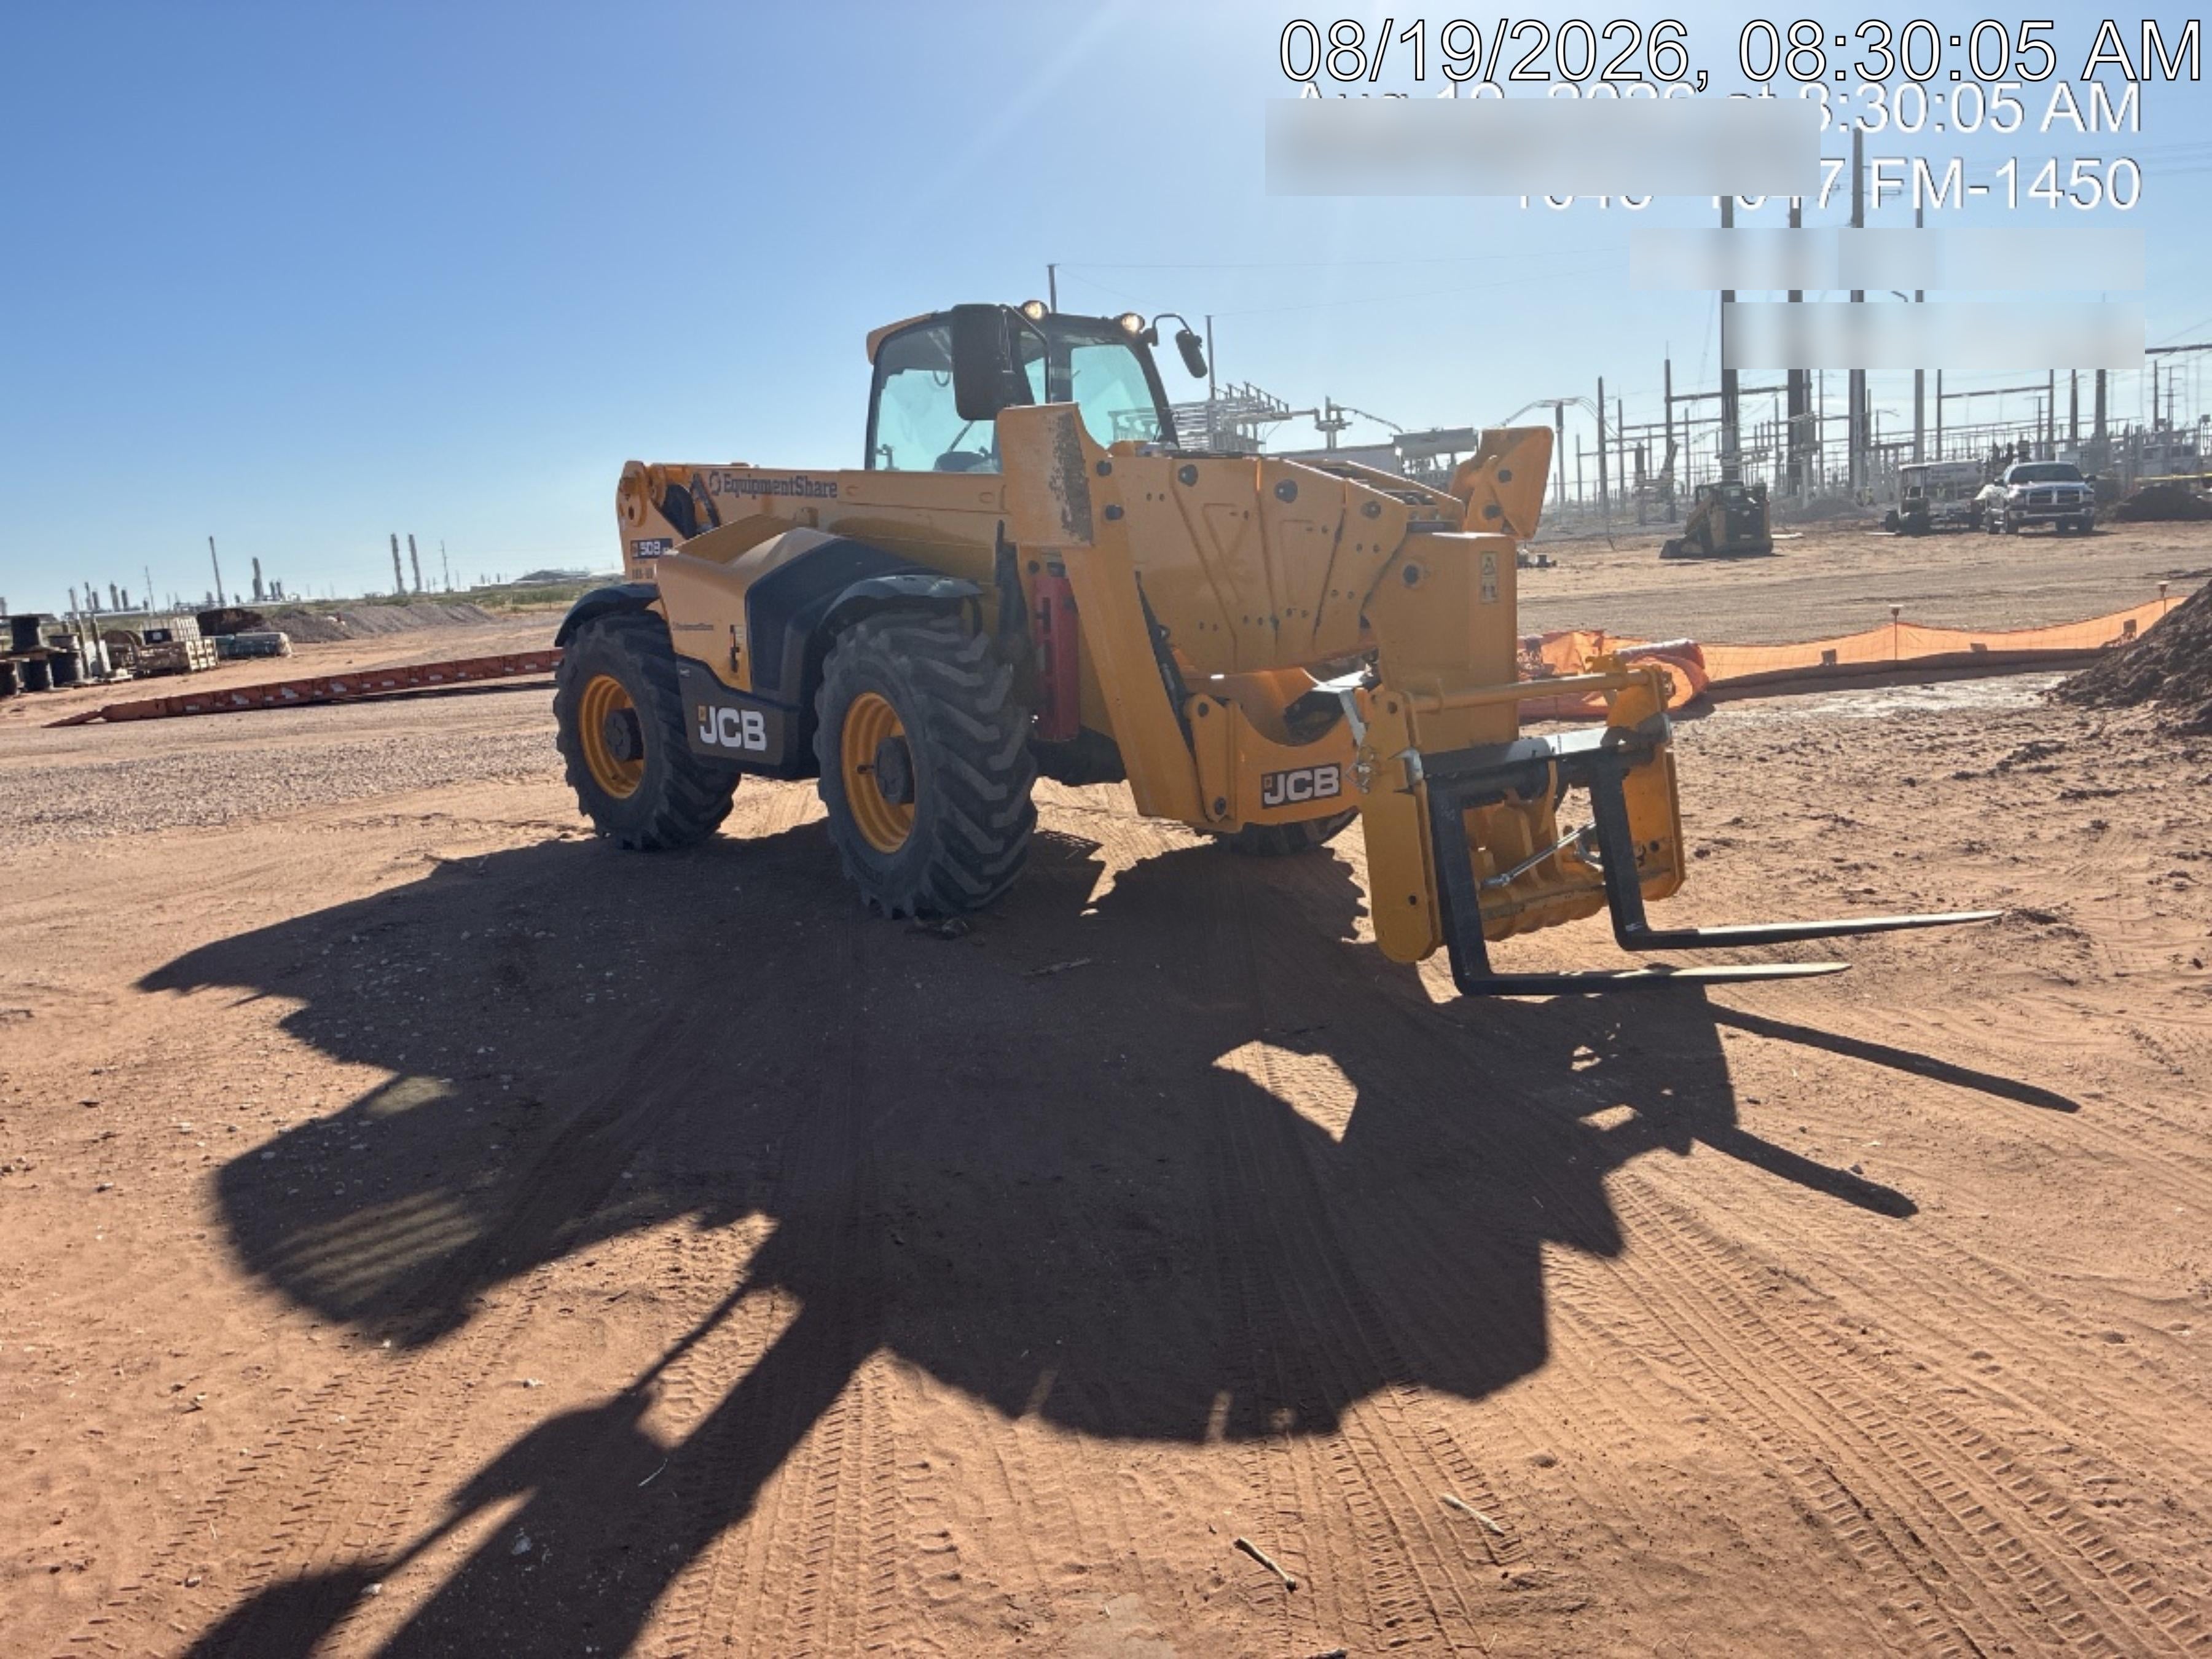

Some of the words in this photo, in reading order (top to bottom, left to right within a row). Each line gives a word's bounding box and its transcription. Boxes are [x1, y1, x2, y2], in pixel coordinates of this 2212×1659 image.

[723, 473, 838, 500] EquipmentShare
[699, 705, 766, 751] JCB
[1263, 766, 1339, 805] JCB
